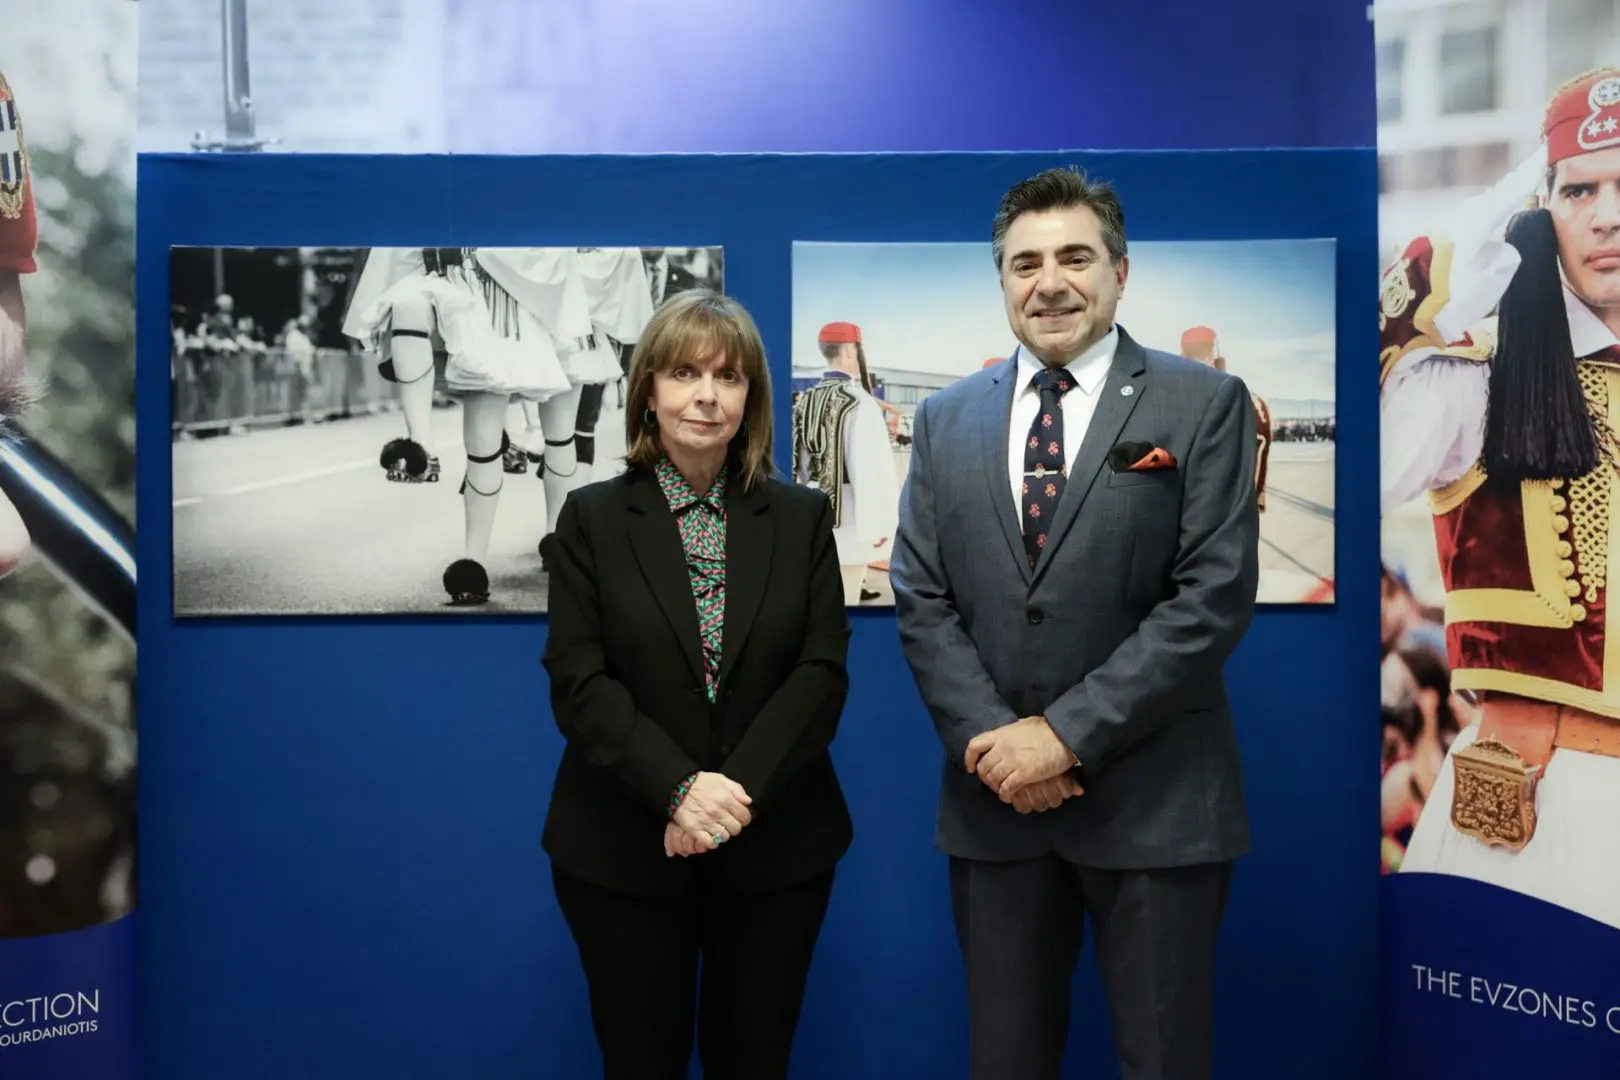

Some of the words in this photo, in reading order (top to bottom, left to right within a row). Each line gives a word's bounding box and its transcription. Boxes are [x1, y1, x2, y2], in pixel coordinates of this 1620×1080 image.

[0, 988, 99, 1028] CTION
[1411, 964, 1462, 998] THE
[1470, 976, 1597, 1028] EVZONES
